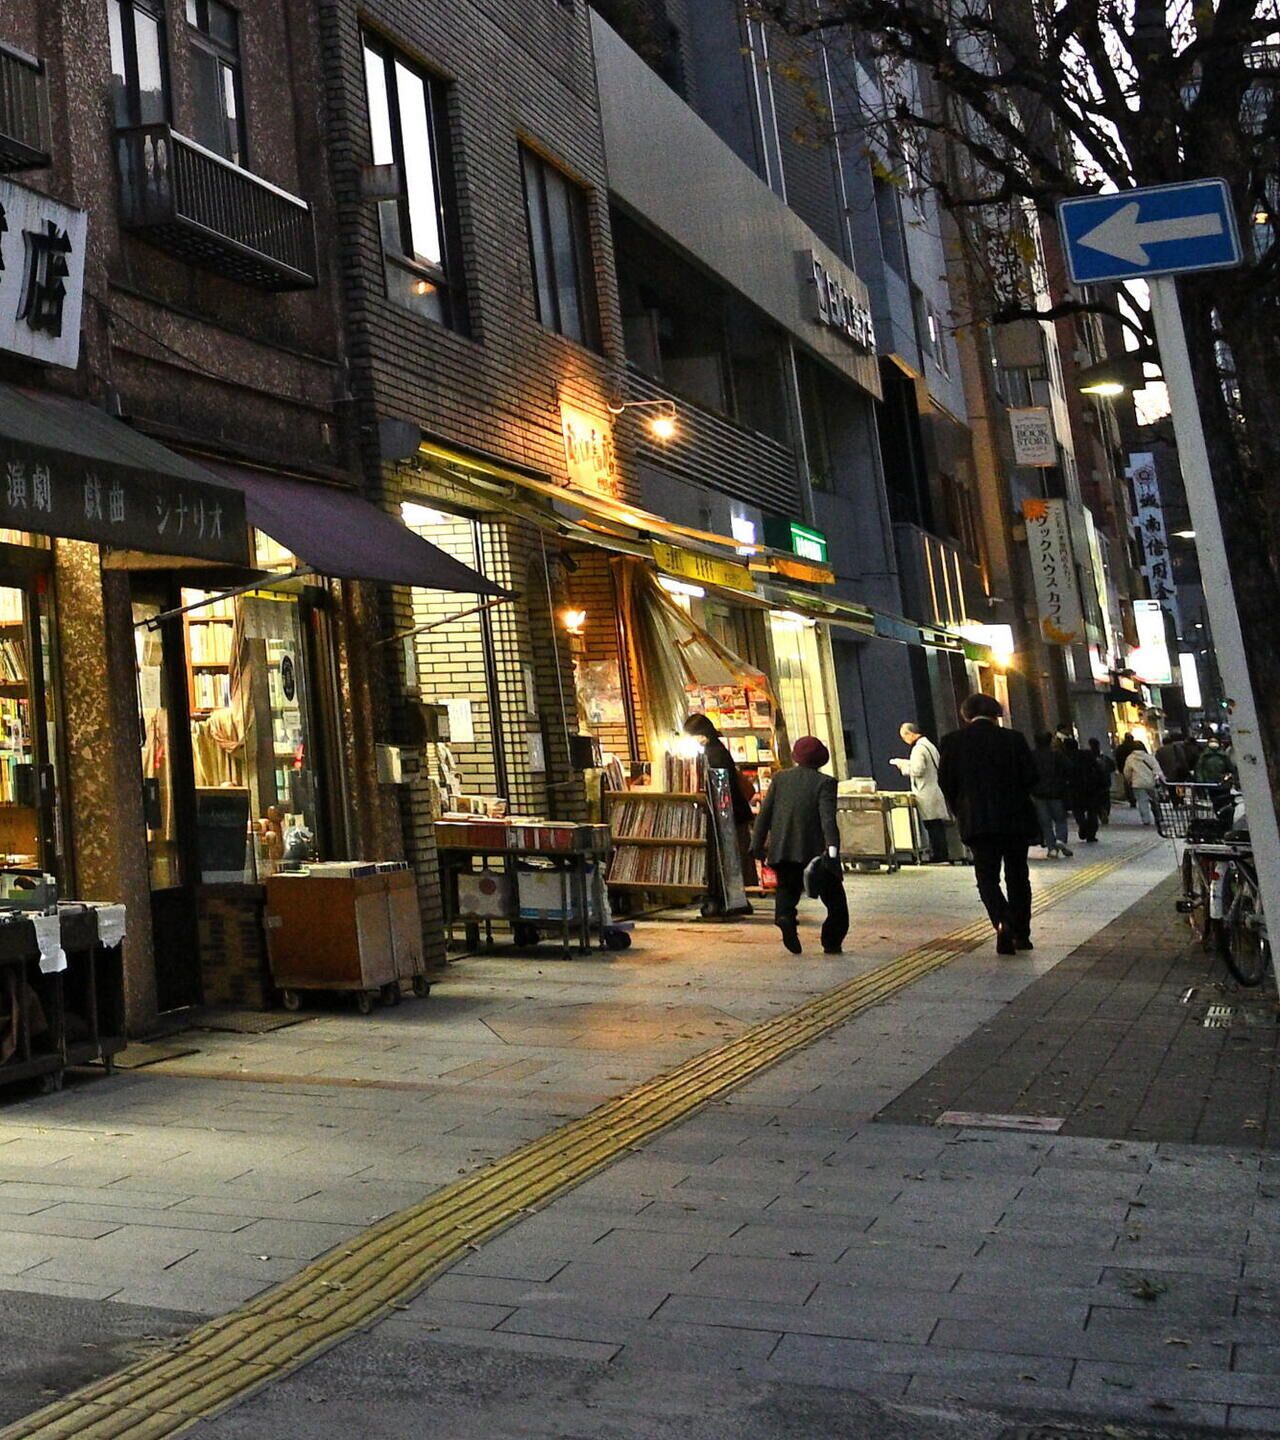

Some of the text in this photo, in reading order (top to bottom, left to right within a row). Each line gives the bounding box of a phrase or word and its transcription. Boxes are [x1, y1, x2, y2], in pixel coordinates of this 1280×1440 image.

[6, 462, 53, 513] 演劇
[154, 495, 224, 541] シナリオ
